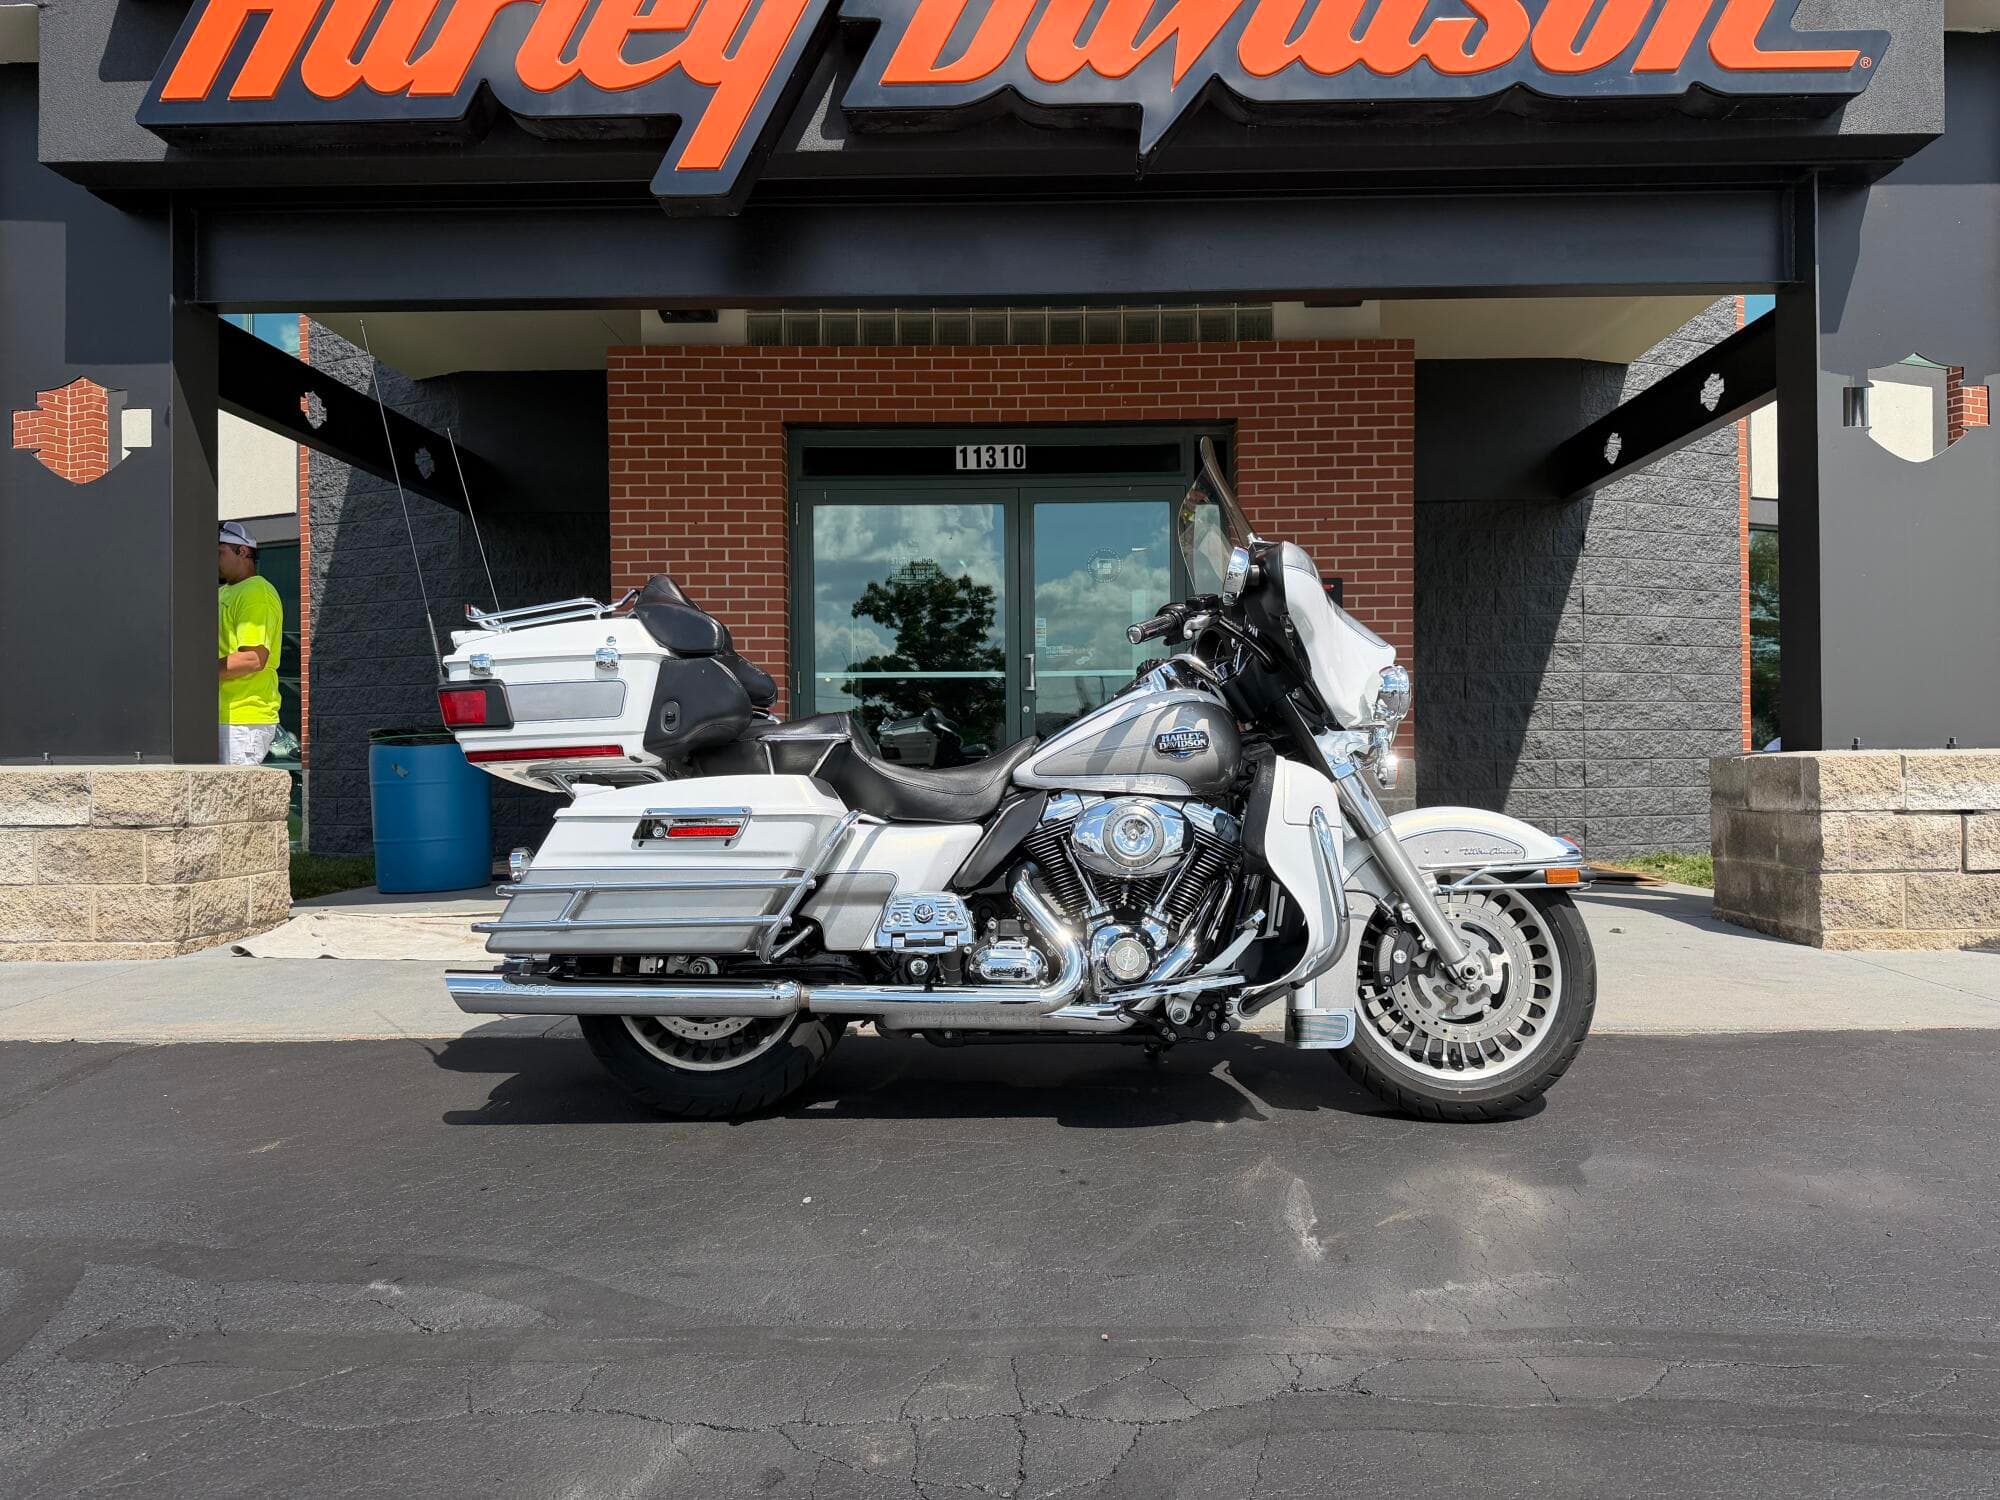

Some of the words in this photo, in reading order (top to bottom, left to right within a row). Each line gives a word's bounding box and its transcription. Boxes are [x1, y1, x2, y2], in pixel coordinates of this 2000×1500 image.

[959, 445, 1025, 468] 11310
[1161, 732, 1204, 743] HARLEY-
[1158, 739, 1207, 750] DAVIDSON
